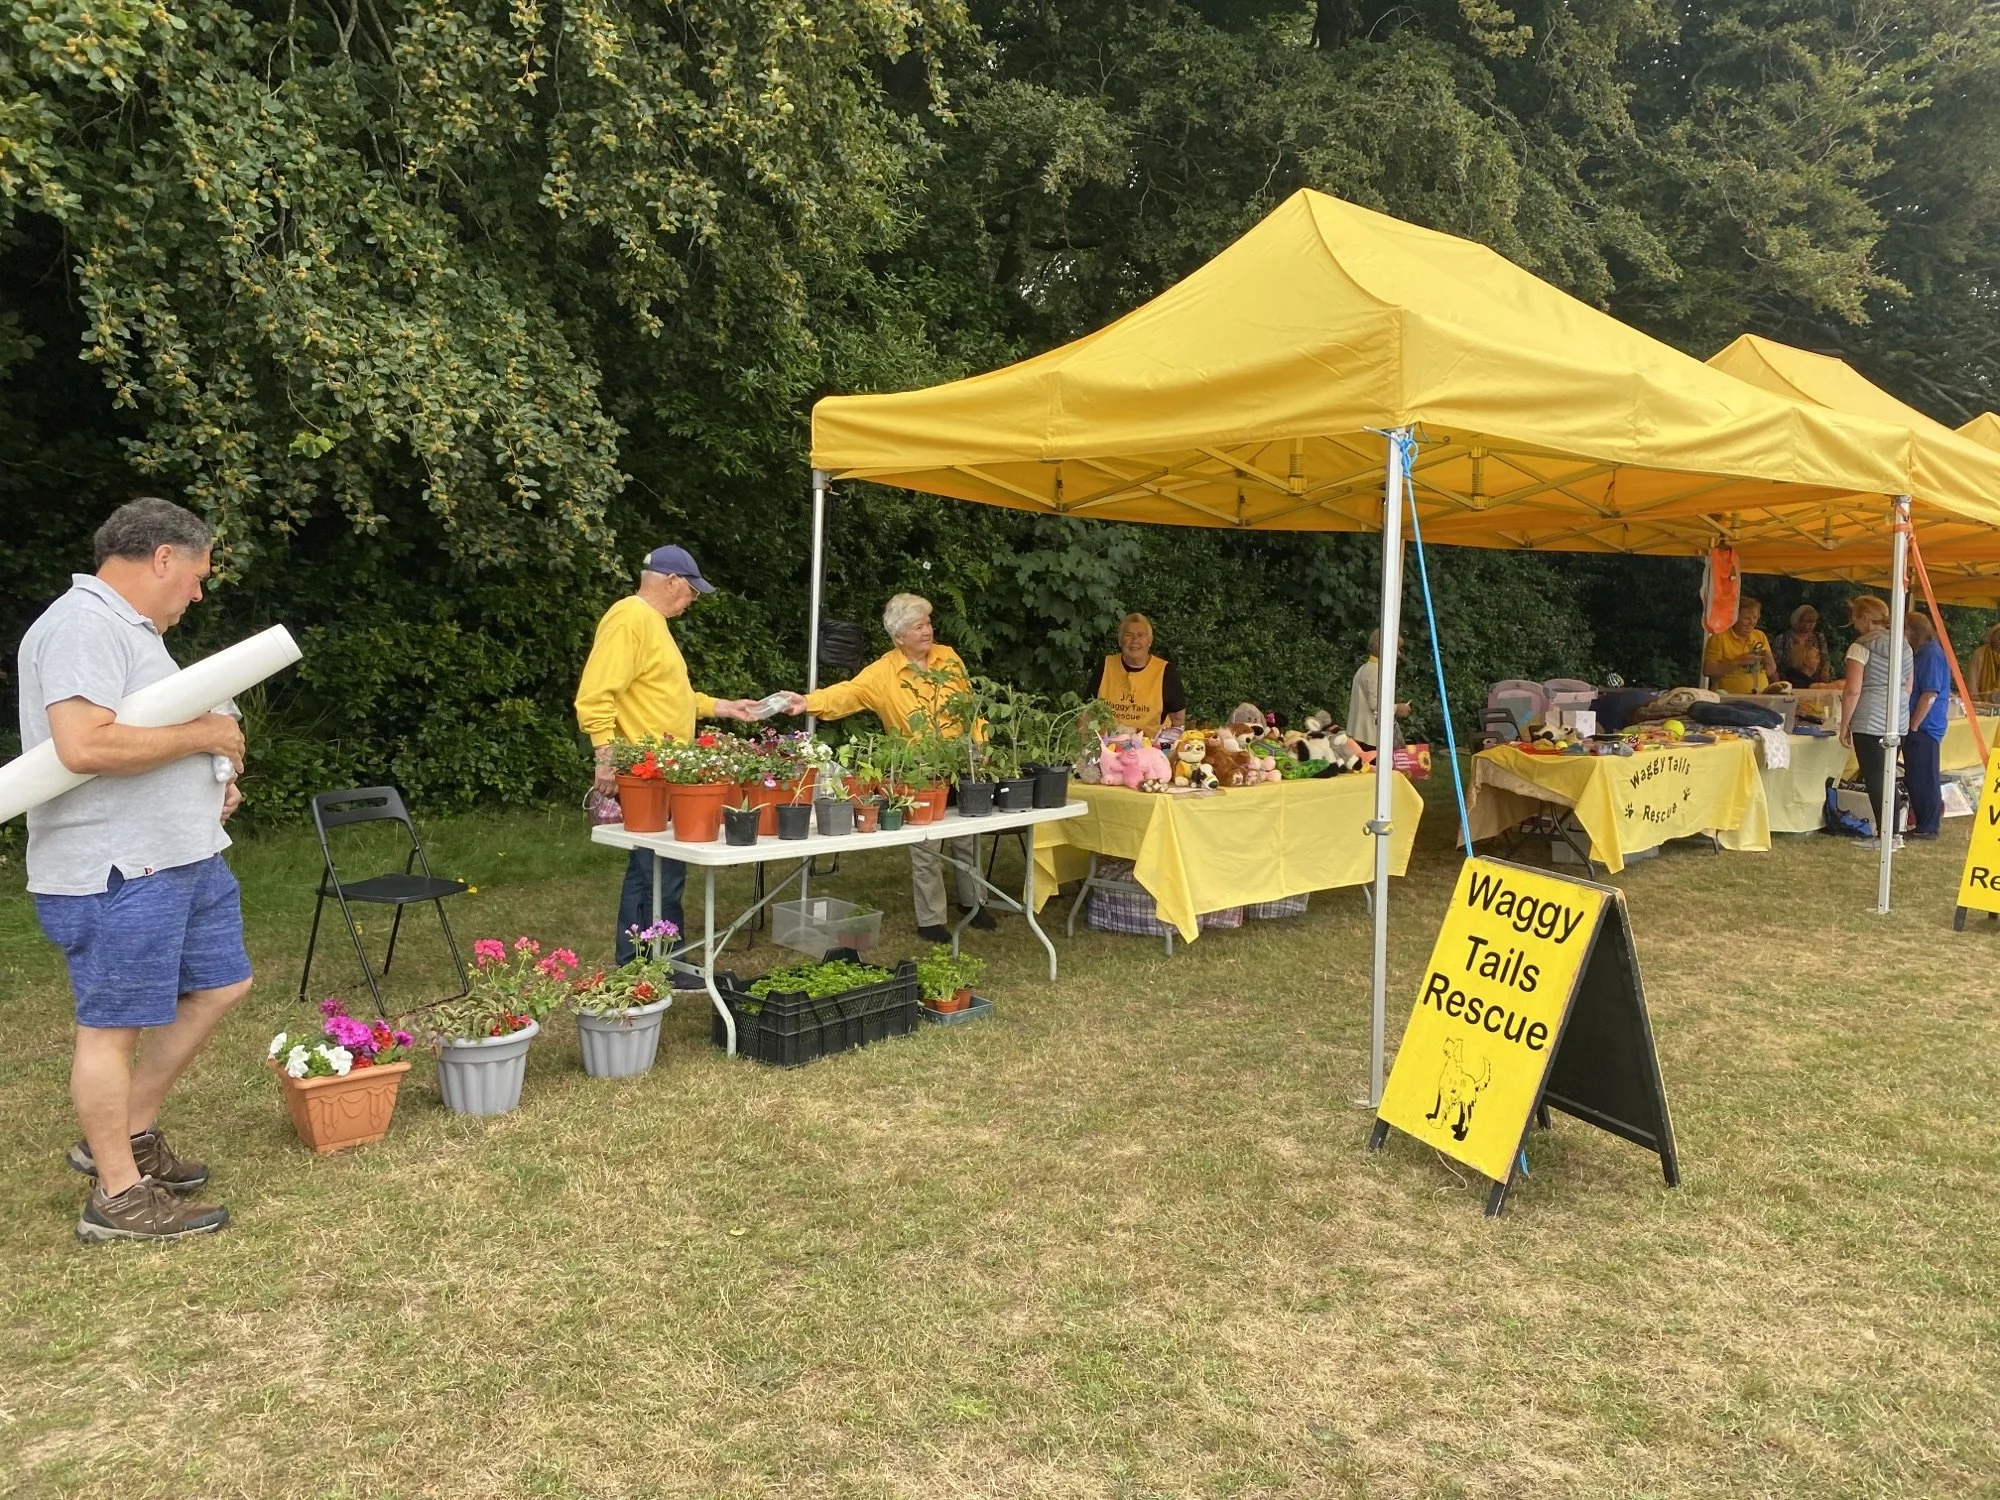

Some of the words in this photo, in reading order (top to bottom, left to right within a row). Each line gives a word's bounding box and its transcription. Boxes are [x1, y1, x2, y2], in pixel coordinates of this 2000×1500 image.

[1111, 710, 1140, 720] Rescue
[1132, 704, 1150, 712] Tails
[1630, 757, 1665, 789] Waggy
[1642, 803, 1677, 823] Rescue
[1467, 871, 1585, 944] Waggy
[1465, 935, 1541, 993] Tails
[1422, 971, 1549, 1051] Rescue
